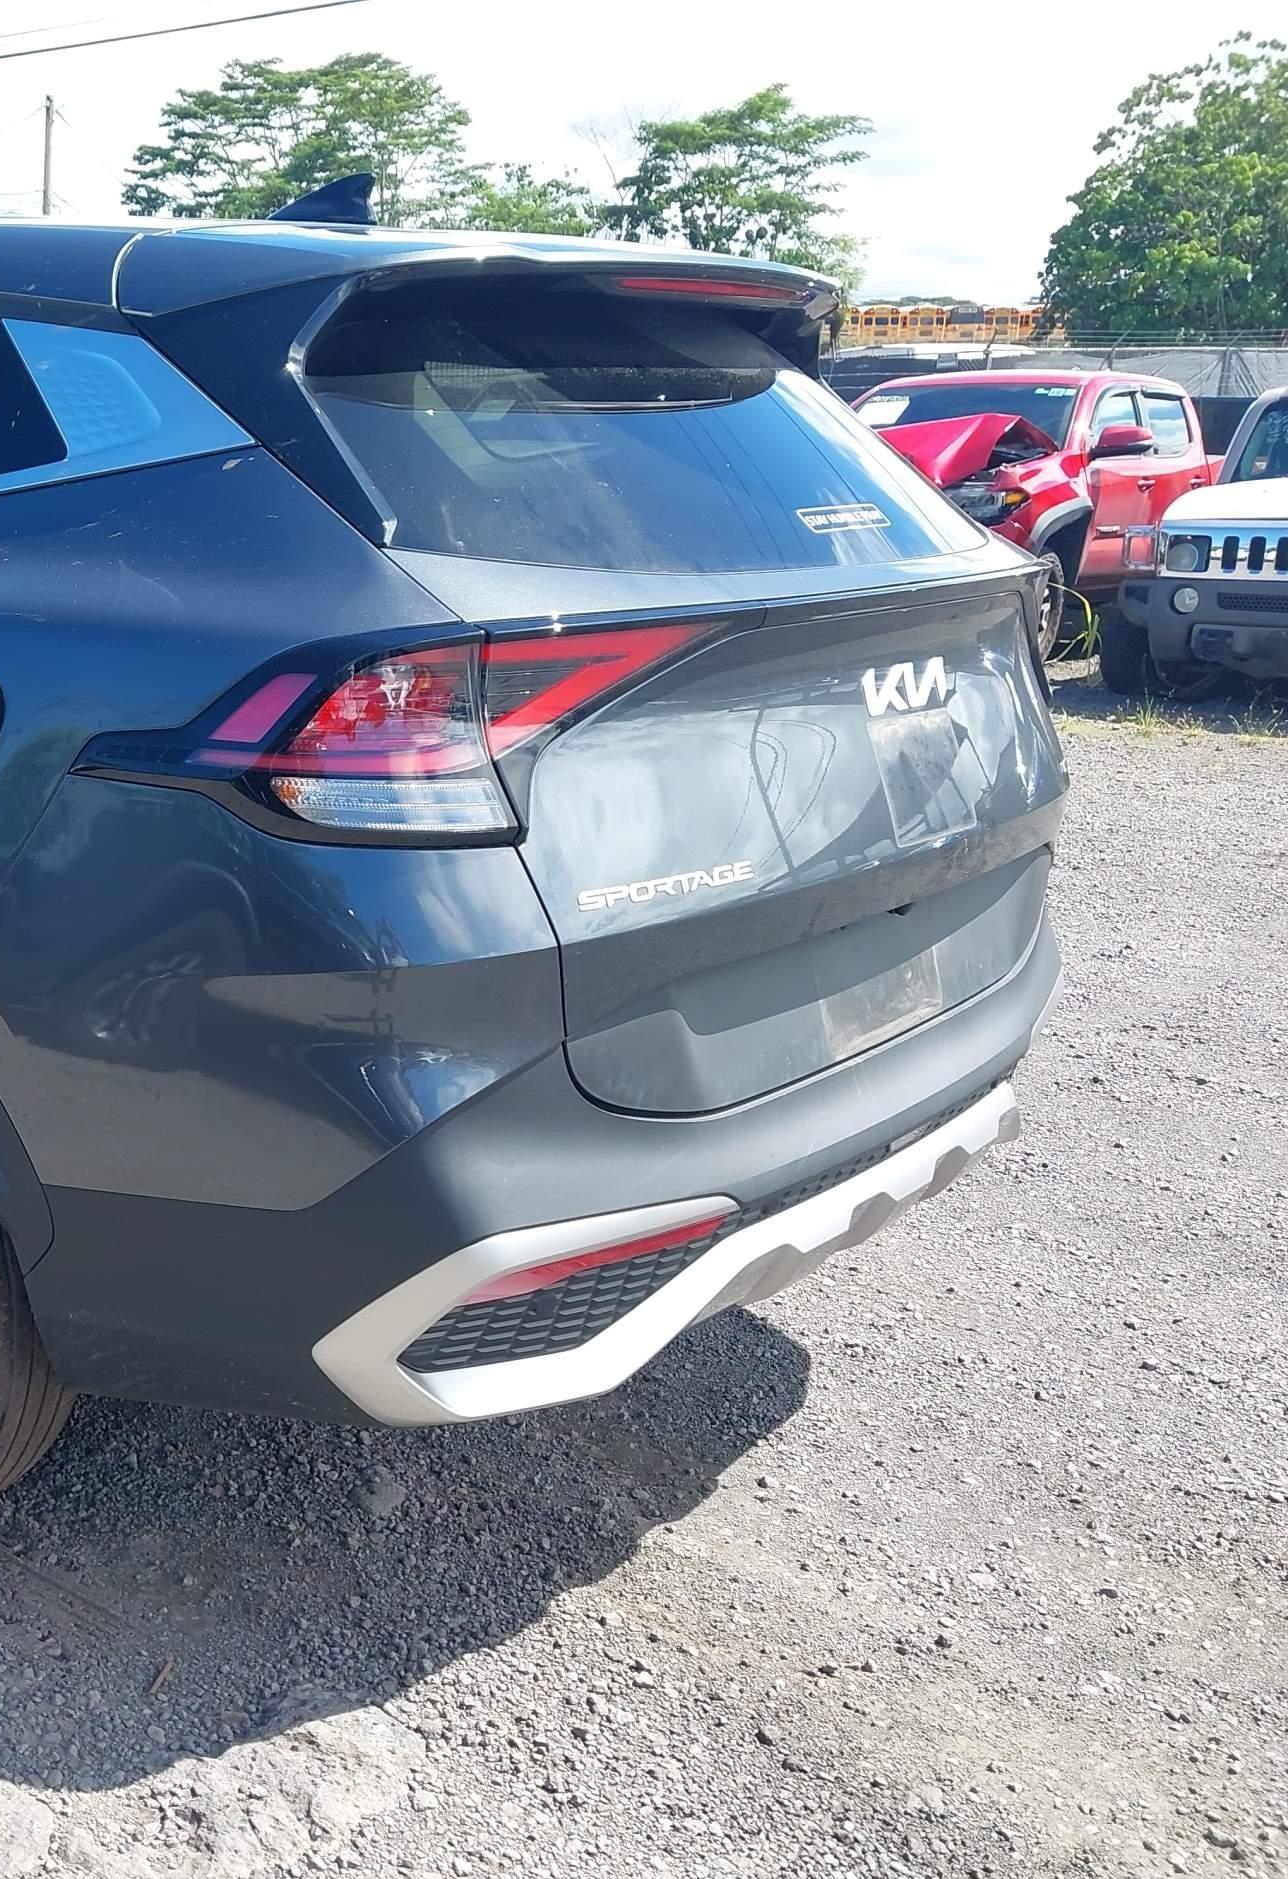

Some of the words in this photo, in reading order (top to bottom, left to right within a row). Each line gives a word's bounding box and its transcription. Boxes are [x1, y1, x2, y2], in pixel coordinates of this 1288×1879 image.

[805, 515, 829, 526] STAY
[861, 656, 948, 717] KIA
[577, 860, 754, 912] SPORTAGE
